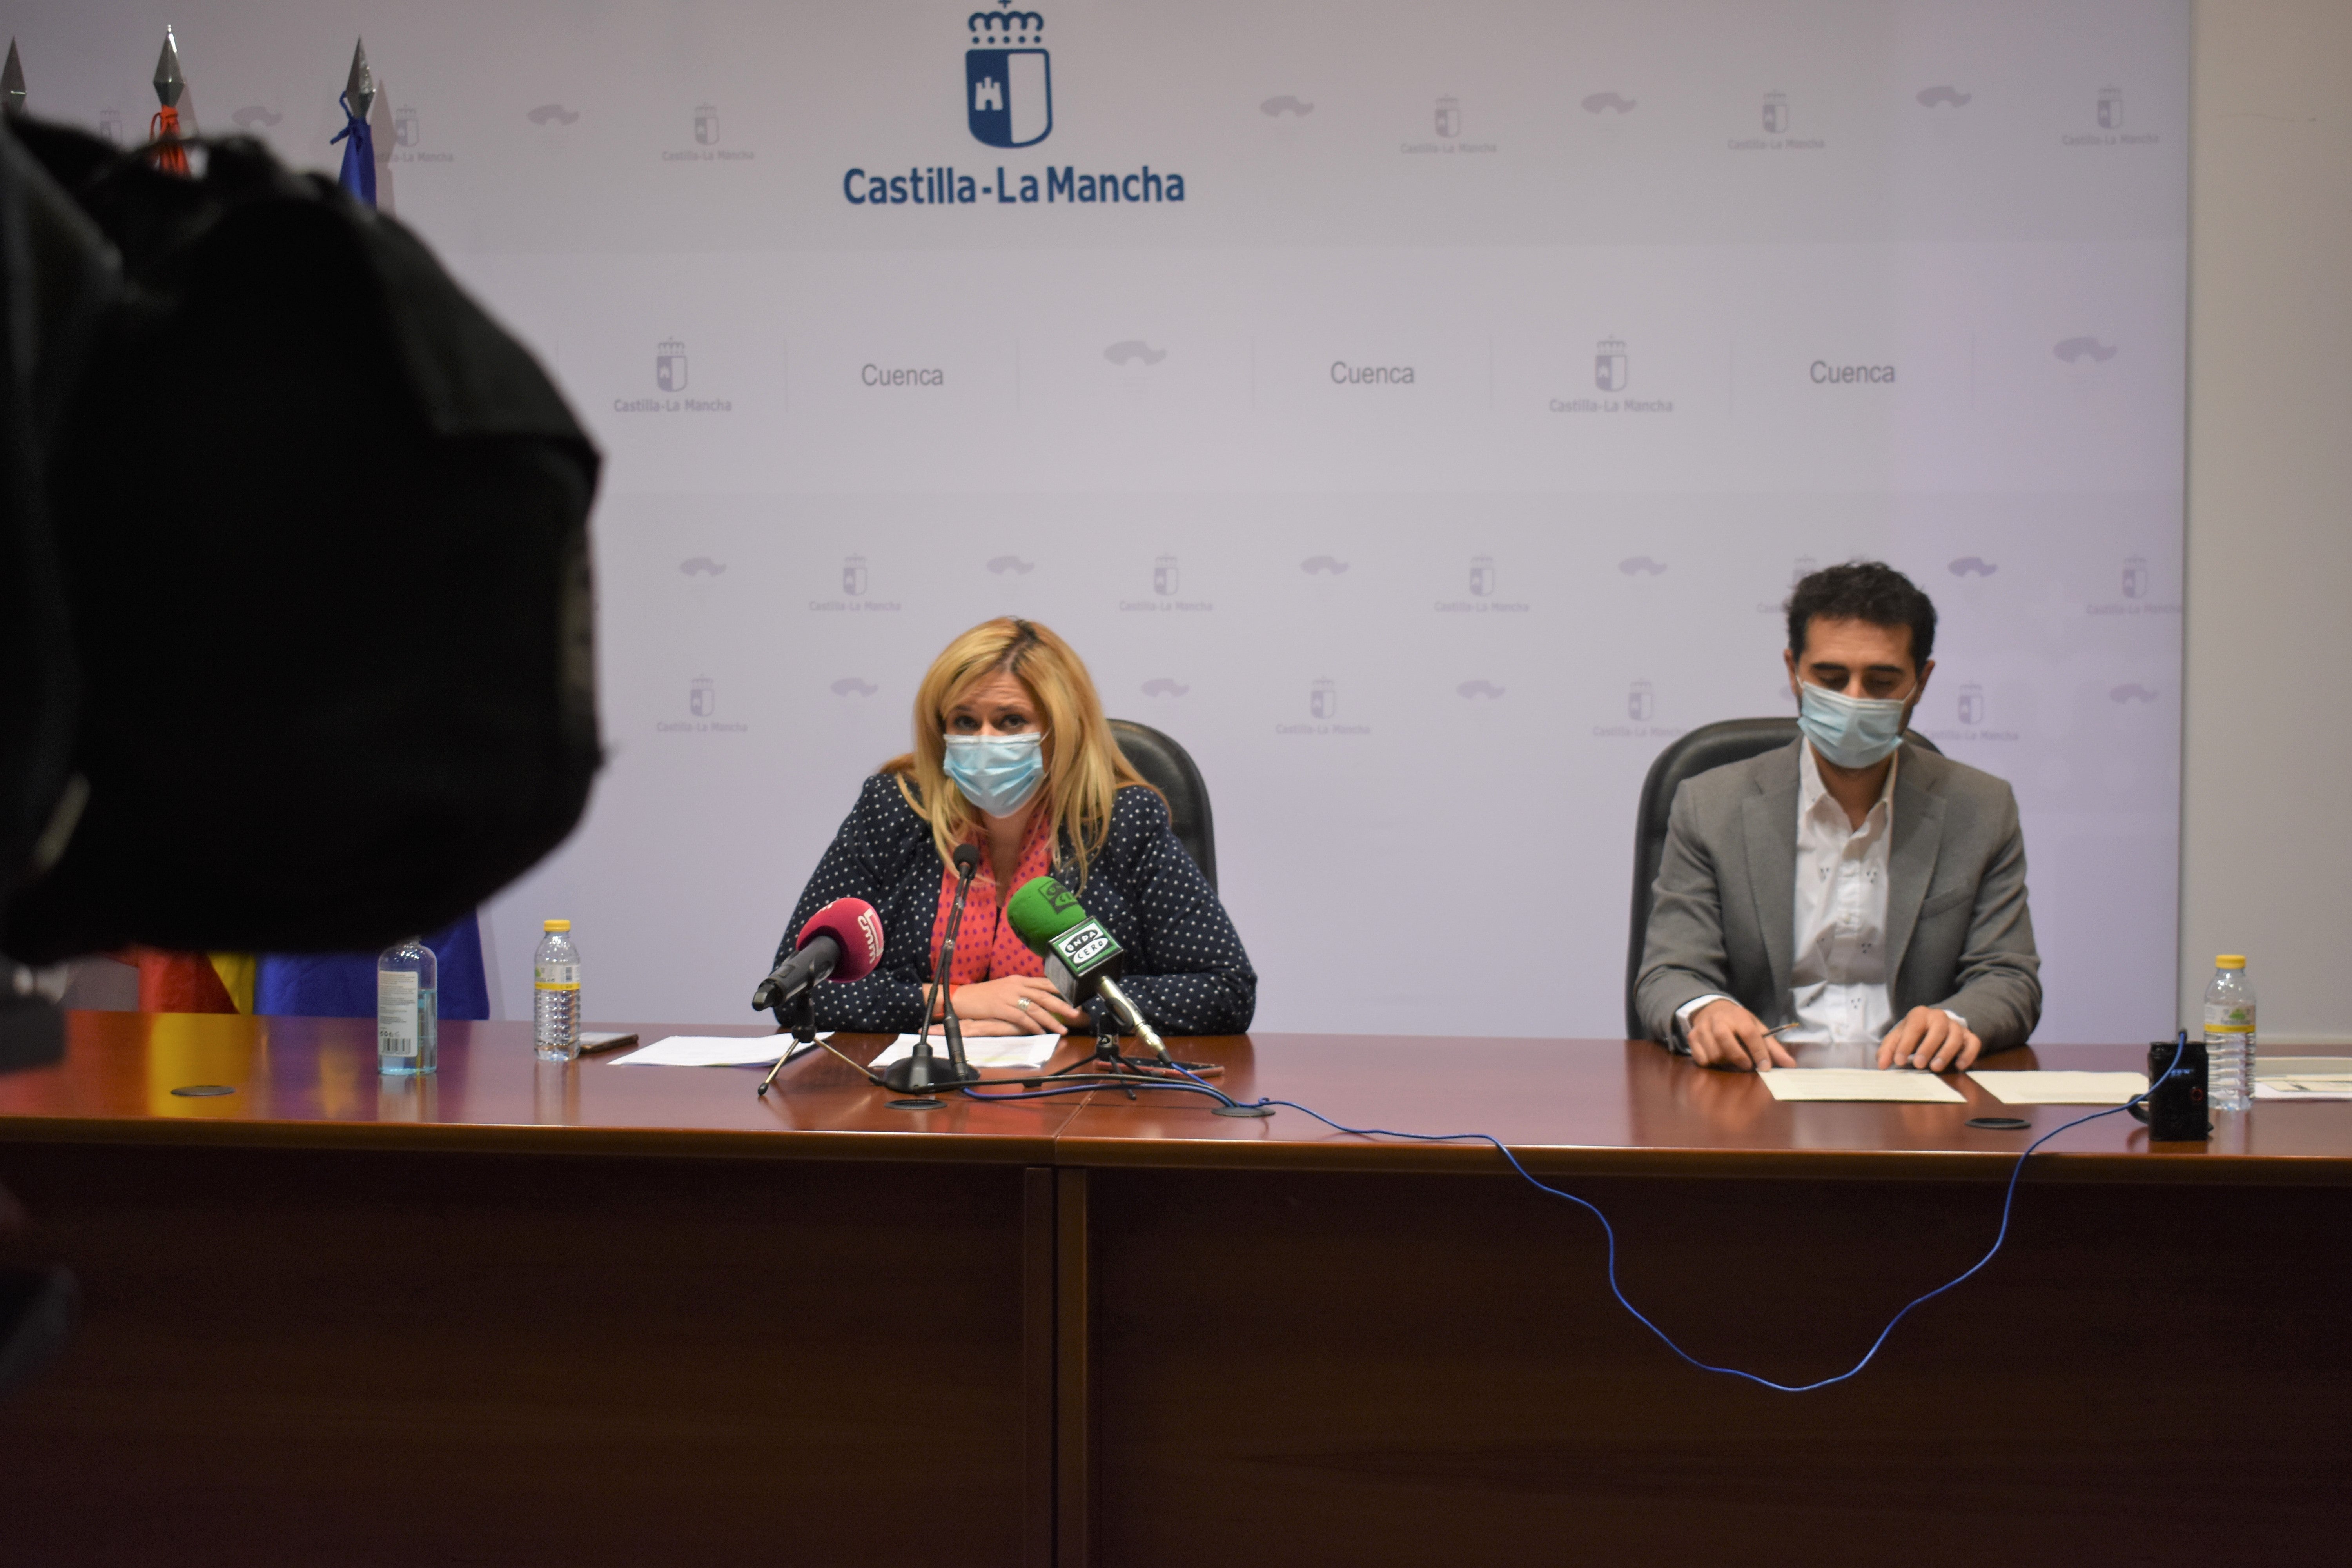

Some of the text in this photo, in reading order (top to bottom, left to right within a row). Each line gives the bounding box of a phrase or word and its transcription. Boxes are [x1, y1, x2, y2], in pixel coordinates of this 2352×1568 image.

[1786, 138, 1826, 149] Mancha
[2120, 133, 2160, 145] Mancha
[1458, 143, 1497, 154] Mancha
[717, 150, 755, 160] Mancha
[862, 363, 944, 386] Cuenca
[1330, 361, 1415, 385] Cuenca
[1809, 360, 1896, 384] Cuenca
[613, 398, 732, 412] Castilla-La Mancha
[1549, 398, 1674, 413] Castilla-La Mancha
[864, 601, 901, 612] Mancha
[1175, 601, 1213, 612] Mancha
[1491, 602, 1530, 613] Mancha
[711, 722, 748, 733] Mancha
[1332, 724, 1371, 735] Mancha
[1067, 931, 1096, 951] ONDA
[1078, 940, 1103, 959] CERO
